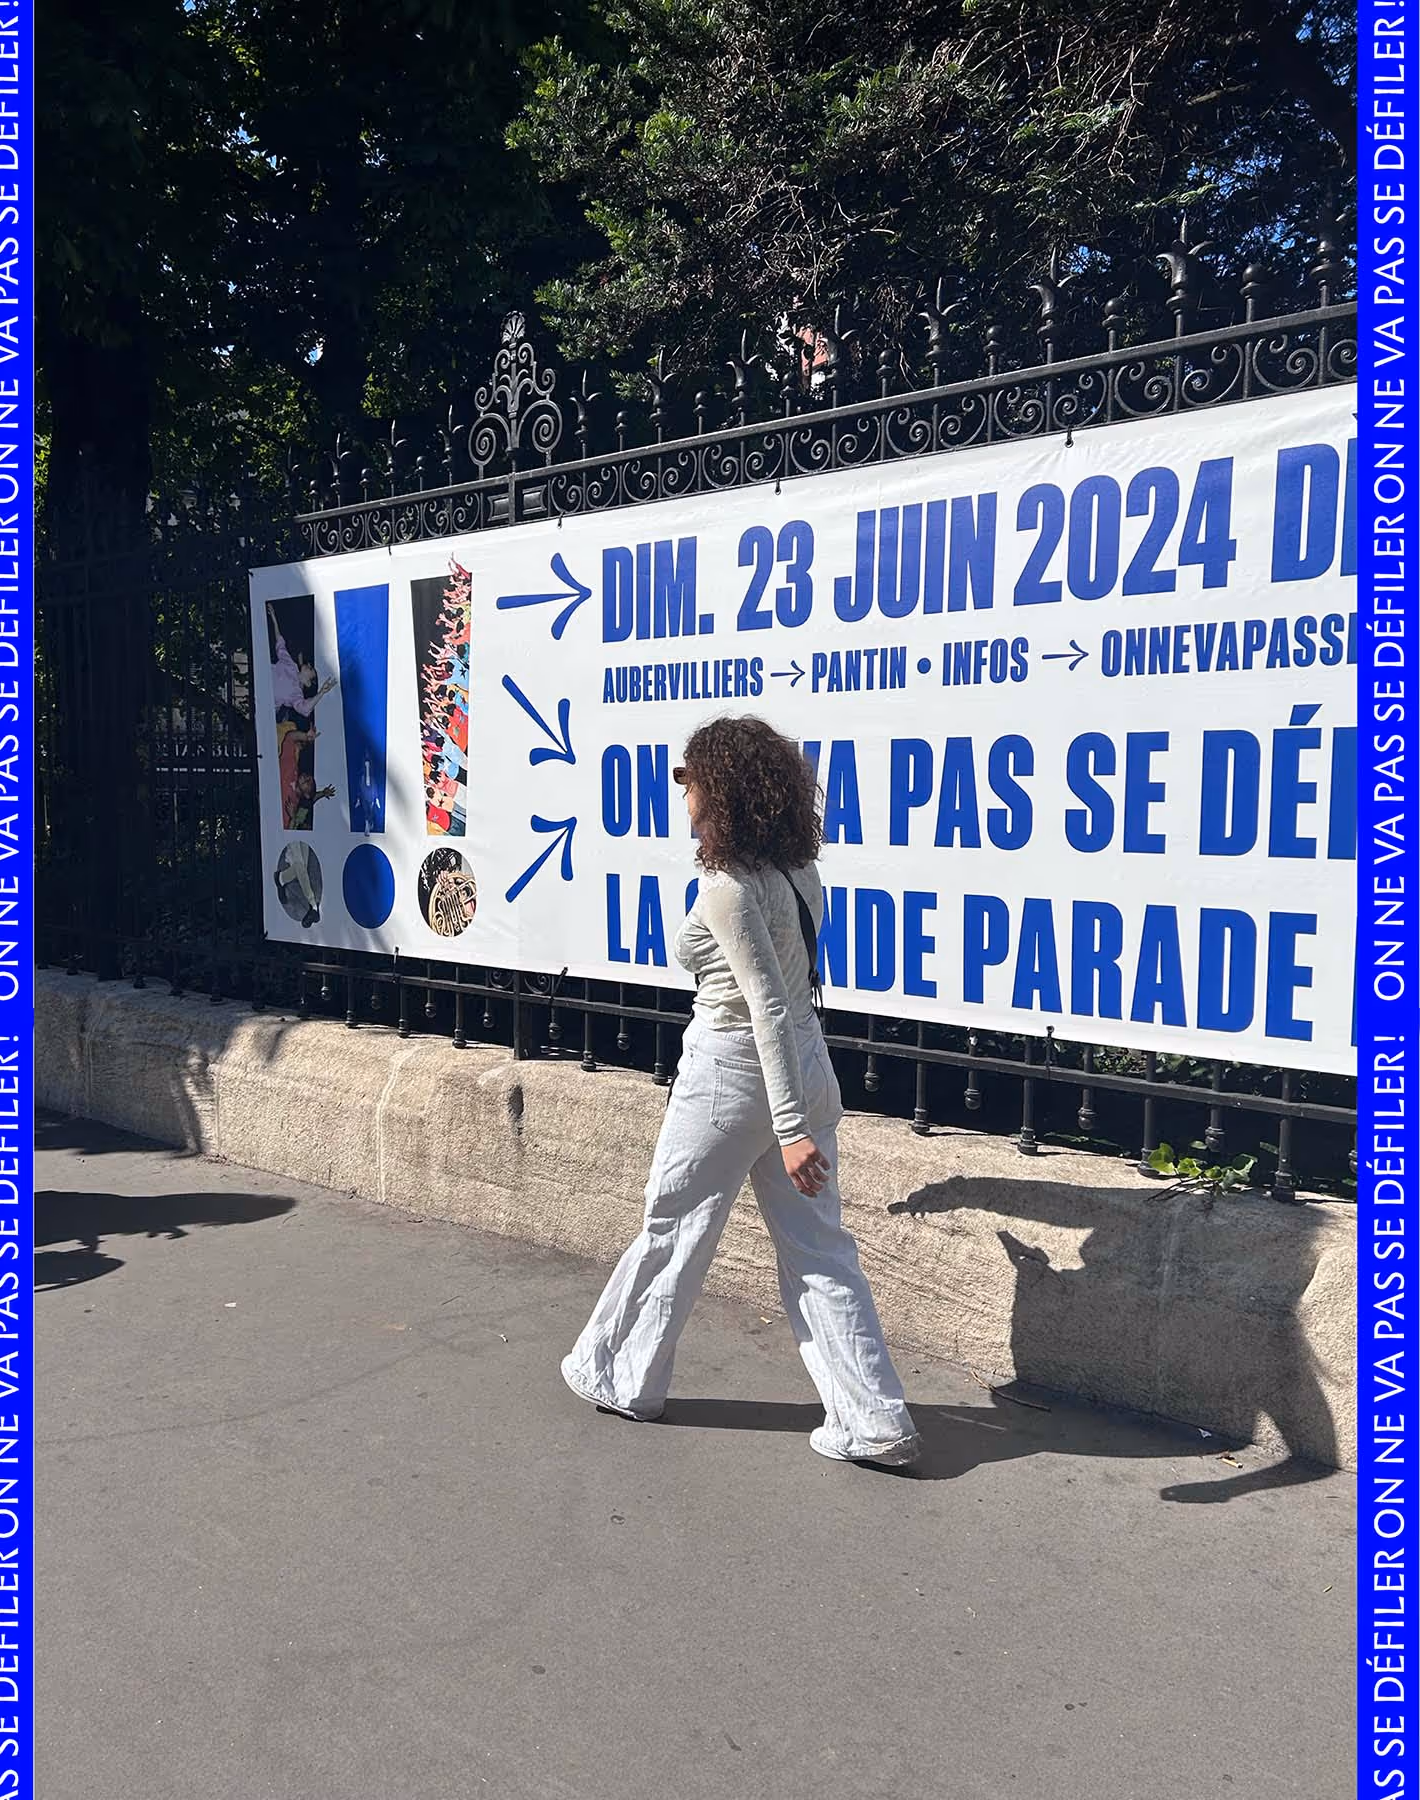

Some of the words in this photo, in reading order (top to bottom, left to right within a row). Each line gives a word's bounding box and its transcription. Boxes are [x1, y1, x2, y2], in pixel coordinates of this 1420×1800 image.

[603, 536, 714, 643] DIM.
[737, 520, 814, 632] 23
[834, 492, 997, 623] JUIN
[1014, 457, 1237, 606] 2024
[1271, 437, 1357, 583] D
[603, 657, 764, 704] AUBERVILLIERS
[812, 646, 907, 693] PANTIN
[942, 637, 1029, 686] INFOS
[601, 744, 669, 838] ON
[889, 735, 1034, 851] PAS
[1065, 731, 1170, 854] SE
[606, 873, 668, 967] LA
[963, 894, 1318, 1042] PARADE
